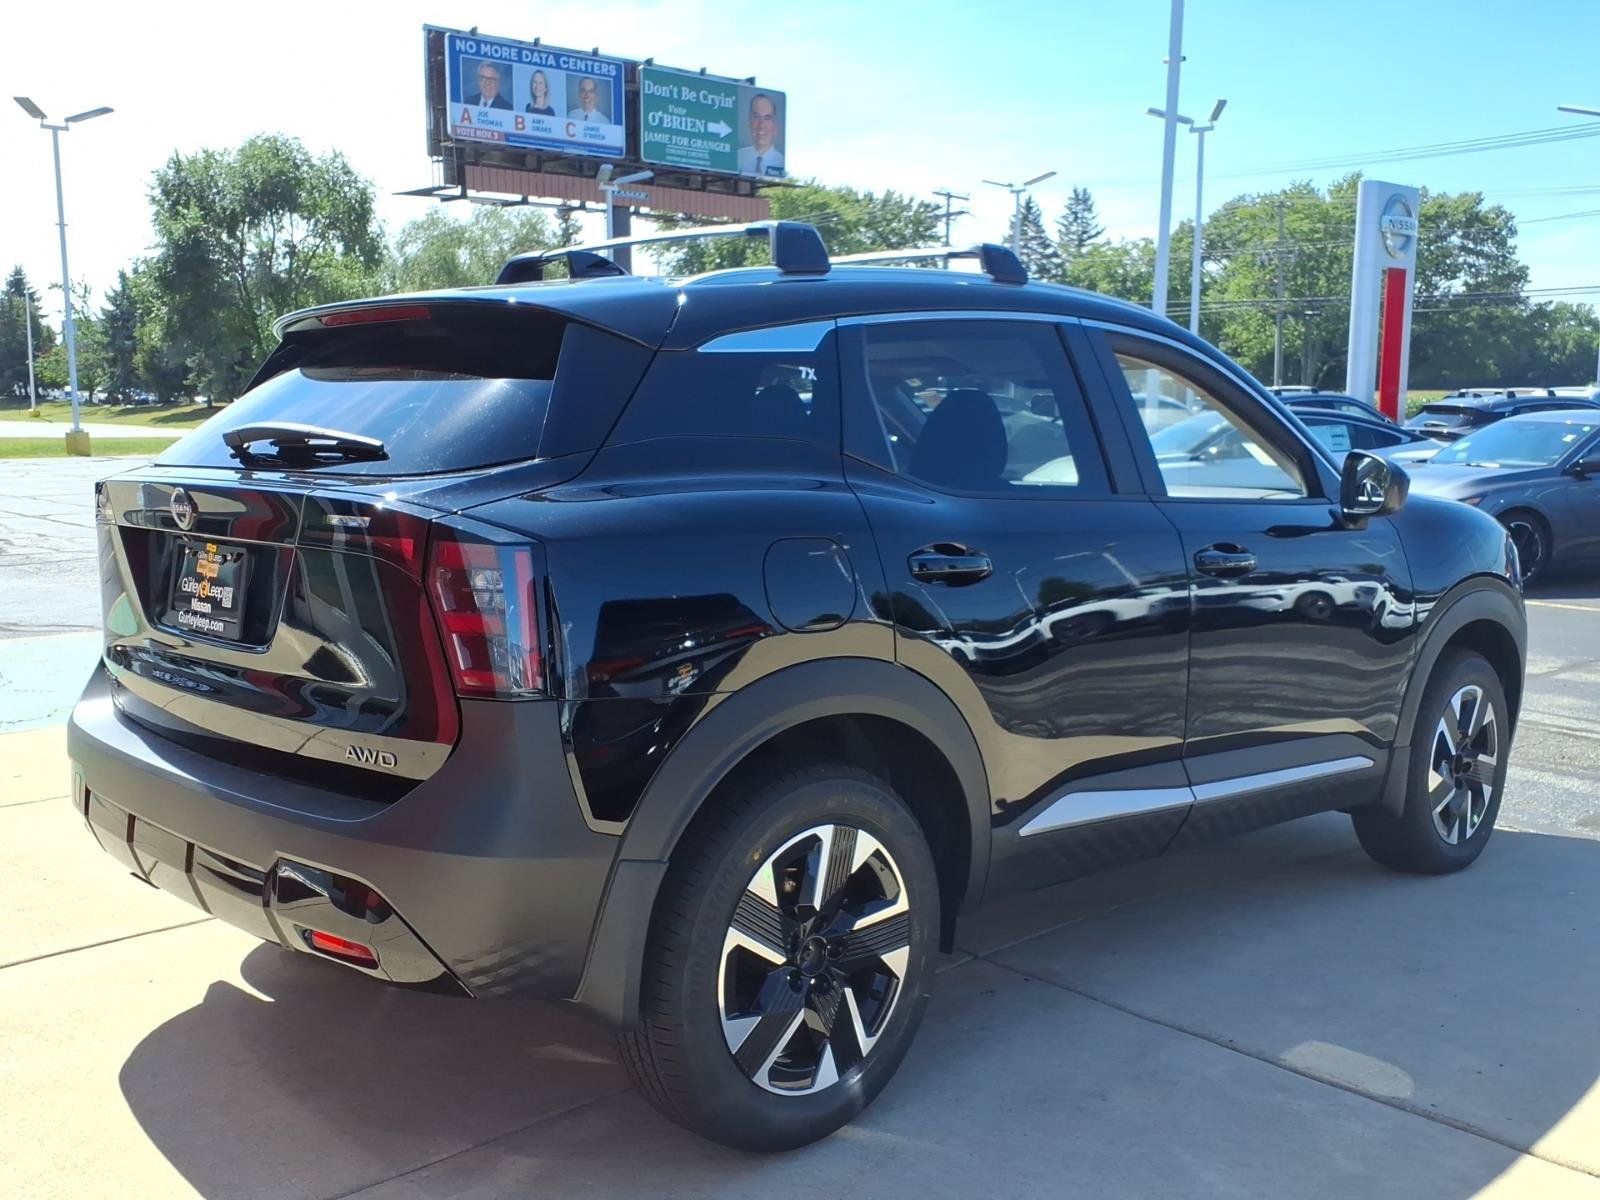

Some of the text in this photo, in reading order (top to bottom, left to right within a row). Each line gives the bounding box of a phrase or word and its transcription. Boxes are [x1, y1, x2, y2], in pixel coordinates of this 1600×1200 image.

[455, 39, 616, 76] NO MORE DATA CENTERS
[643, 80, 736, 109] Don't Be Cryin'
[460, 107, 472, 125] A
[668, 104, 687, 115] Vote
[476, 118, 503, 128] THOMAS
[515, 115, 525, 131] B
[566, 122, 576, 138] C
[648, 111, 705, 133] O'BRIEN
[455, 127, 475, 138] VOTE
[644, 131, 731, 153] JAMIE FOR GRANGER
[182, 577, 199, 597] Gurley
[208, 581, 224, 602] Leep
[191, 598, 211, 613] Nissan
[178, 611, 224, 631] Gurleyleep.com
[345, 744, 398, 768] AWD
